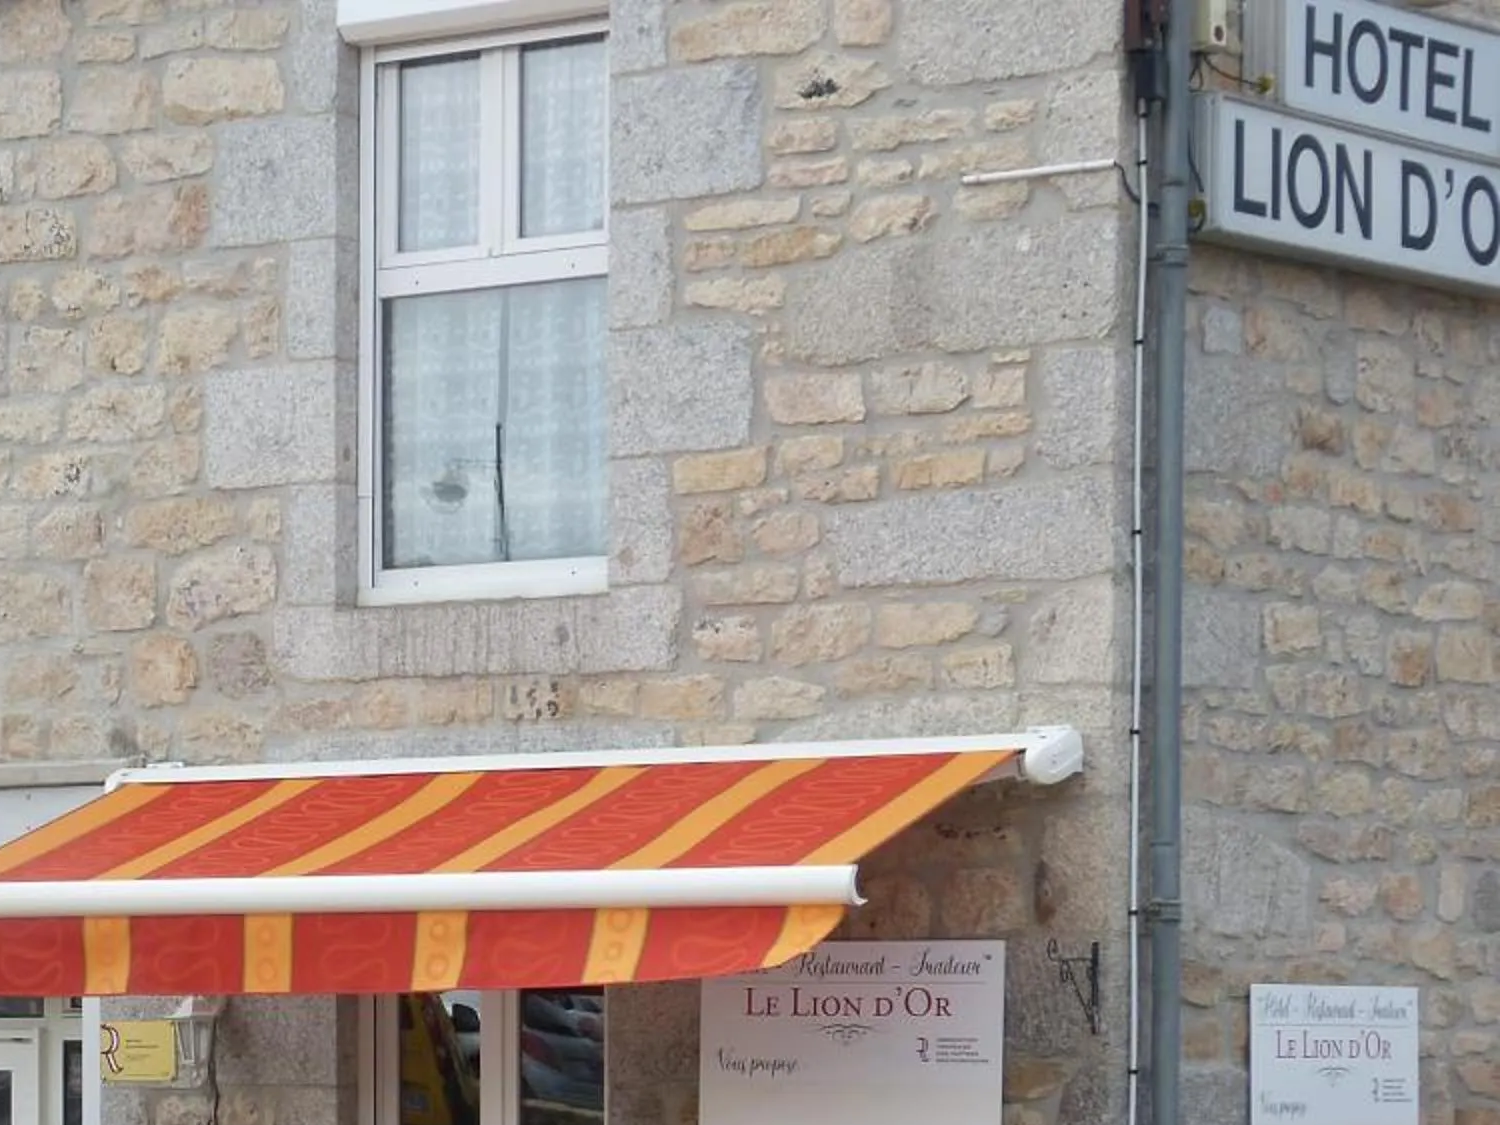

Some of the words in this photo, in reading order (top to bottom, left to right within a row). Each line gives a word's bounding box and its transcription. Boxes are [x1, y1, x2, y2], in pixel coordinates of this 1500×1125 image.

[1304, 5, 1492, 133] HOTEL
[1233, 118, 1373, 241] LION
[743, 987, 780, 1018] LE
[790, 987, 862, 1018] LION
[1301, 1029, 1344, 1060] LION
